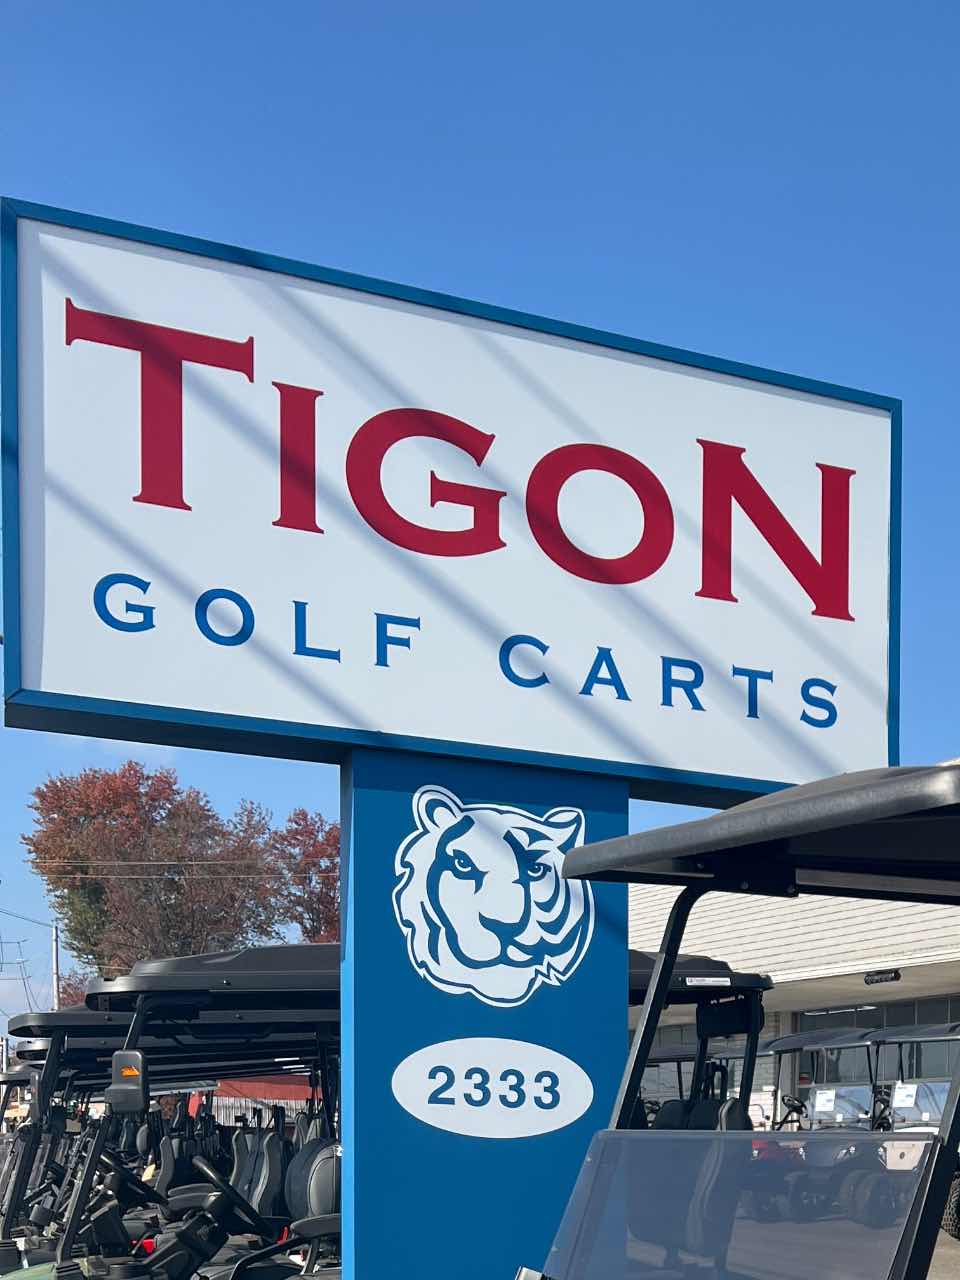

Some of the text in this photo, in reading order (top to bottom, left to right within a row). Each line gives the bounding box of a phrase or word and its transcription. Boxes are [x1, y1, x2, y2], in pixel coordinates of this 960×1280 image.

[65, 297, 857, 622] TIGON
[94, 573, 840, 729] GOLF CARTS
[428, 1065, 560, 1110] 2333
